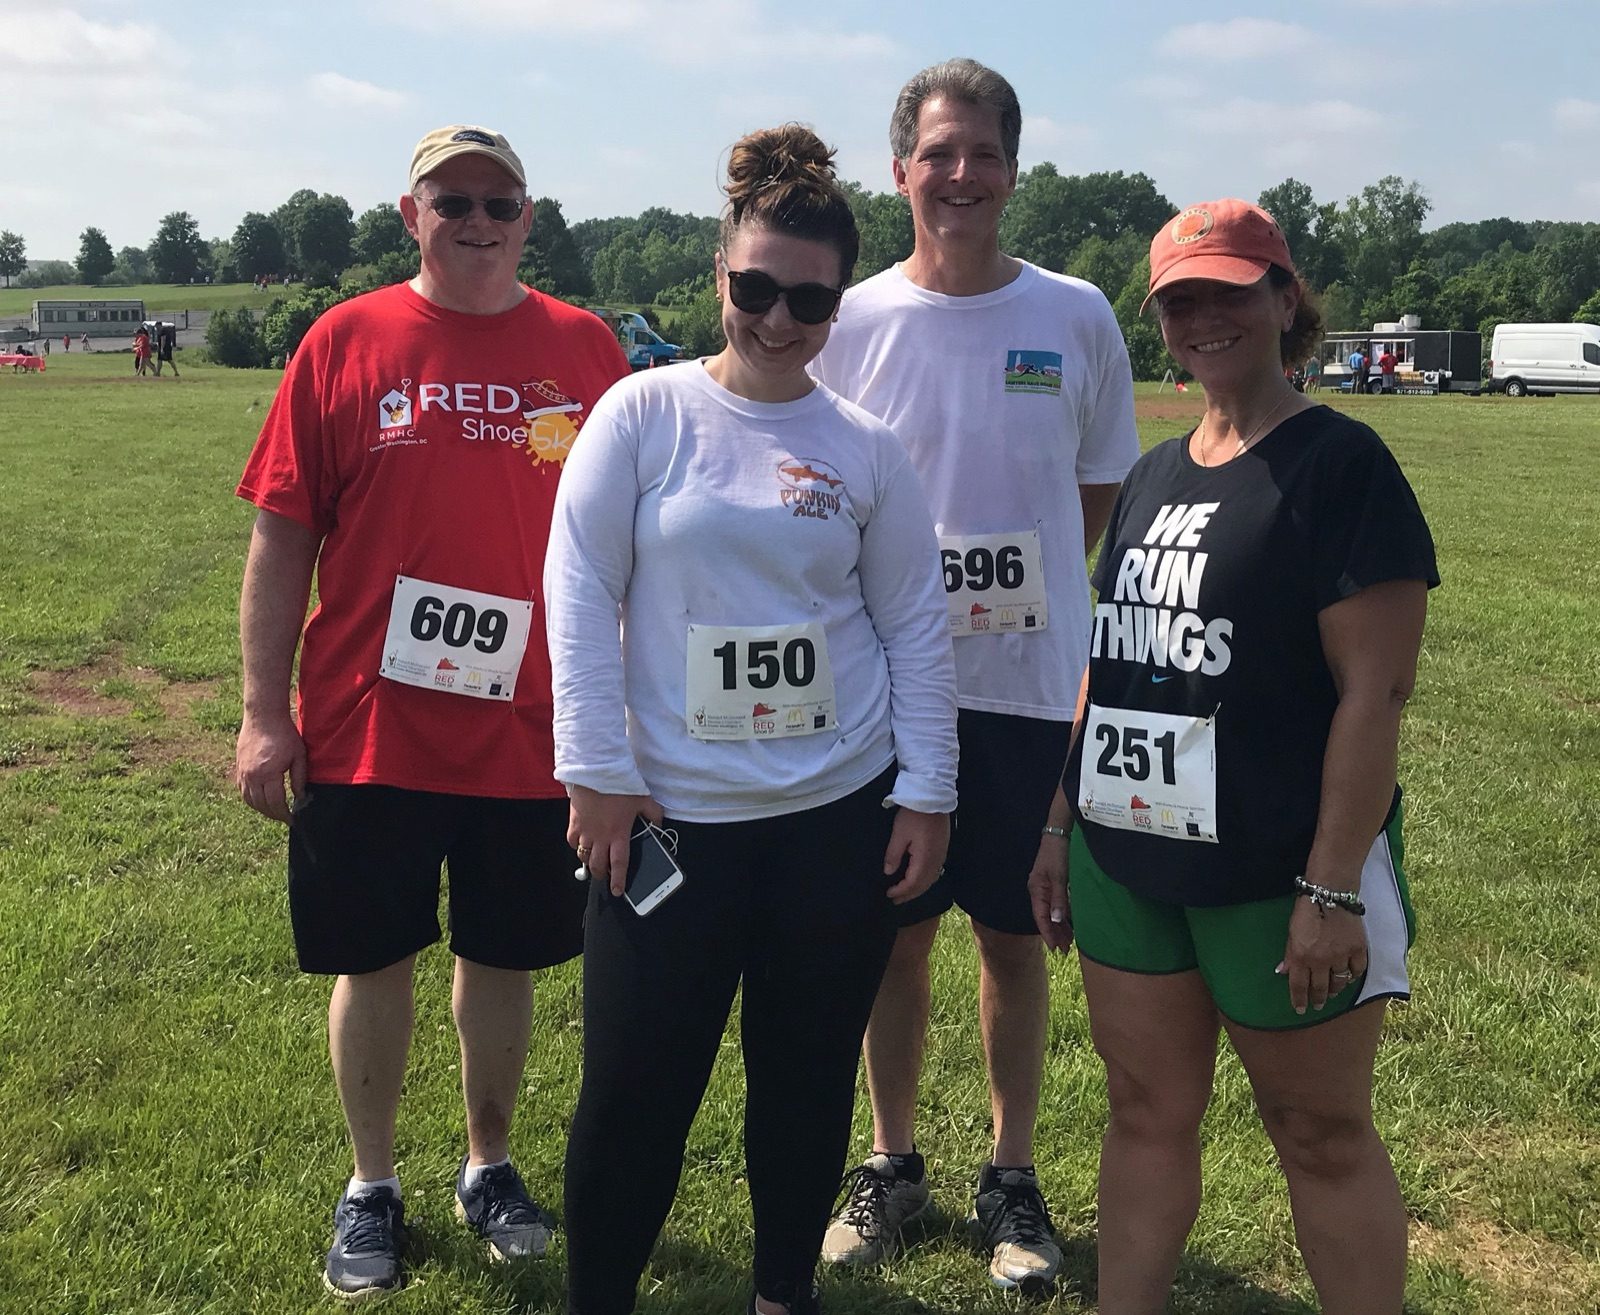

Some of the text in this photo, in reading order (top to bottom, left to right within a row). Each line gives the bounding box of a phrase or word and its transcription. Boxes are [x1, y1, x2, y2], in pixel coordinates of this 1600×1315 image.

[418, 383, 521, 414] RED
[379, 429, 414, 441] RMHC
[462, 418, 528, 444] Shoe
[780, 489, 841, 515] PUNKIN
[793, 505, 829, 520] ALE
[1142, 502, 1221, 547] WE
[940, 545, 1025, 593] 696
[1113, 548, 1209, 609] RUN
[410, 596, 509, 654] 609
[1091, 603, 1234, 676] THINGS
[435, 674, 455, 685] RED
[713, 638, 816, 690] 150
[753, 721, 775, 730] RED
[1096, 723, 1176, 785] 251
[1132, 814, 1152, 825] RED
